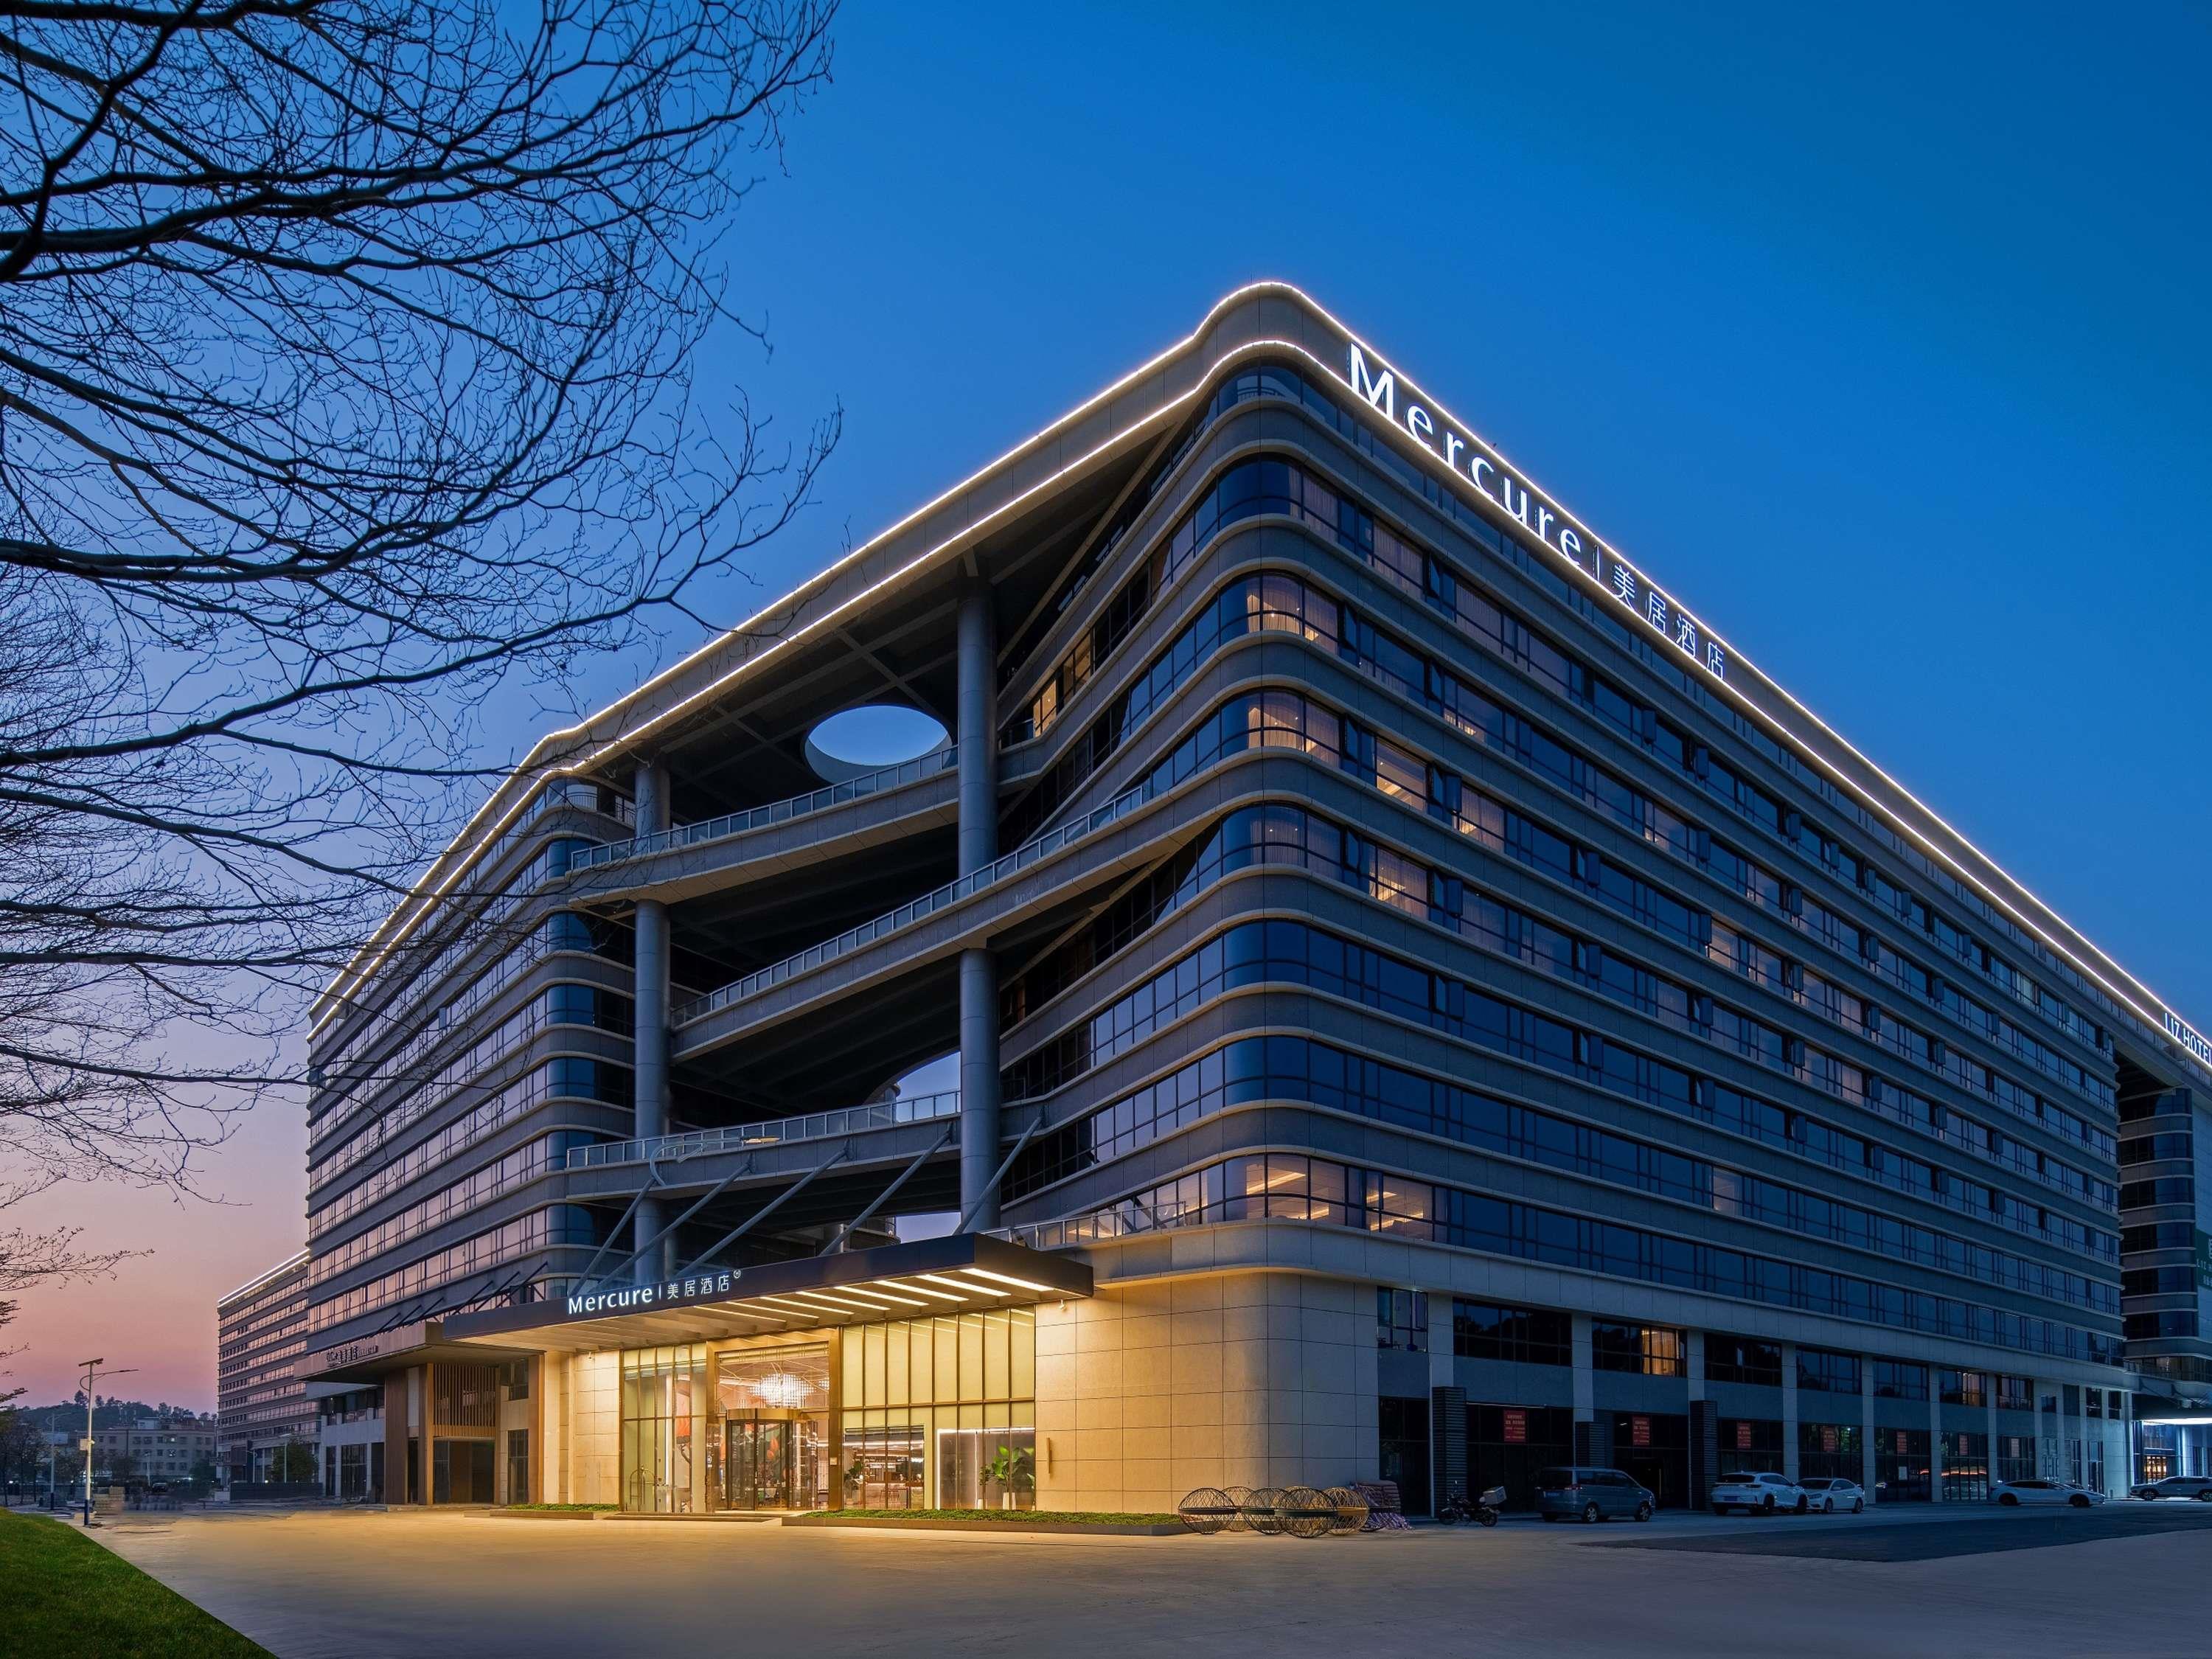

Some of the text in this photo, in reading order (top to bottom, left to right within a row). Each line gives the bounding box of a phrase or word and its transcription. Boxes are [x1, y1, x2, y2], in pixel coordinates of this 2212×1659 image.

[1351, 343, 1724, 681] Mercure 美居酒店
[568, 1275, 729, 1314] Mercure 美居酒店
